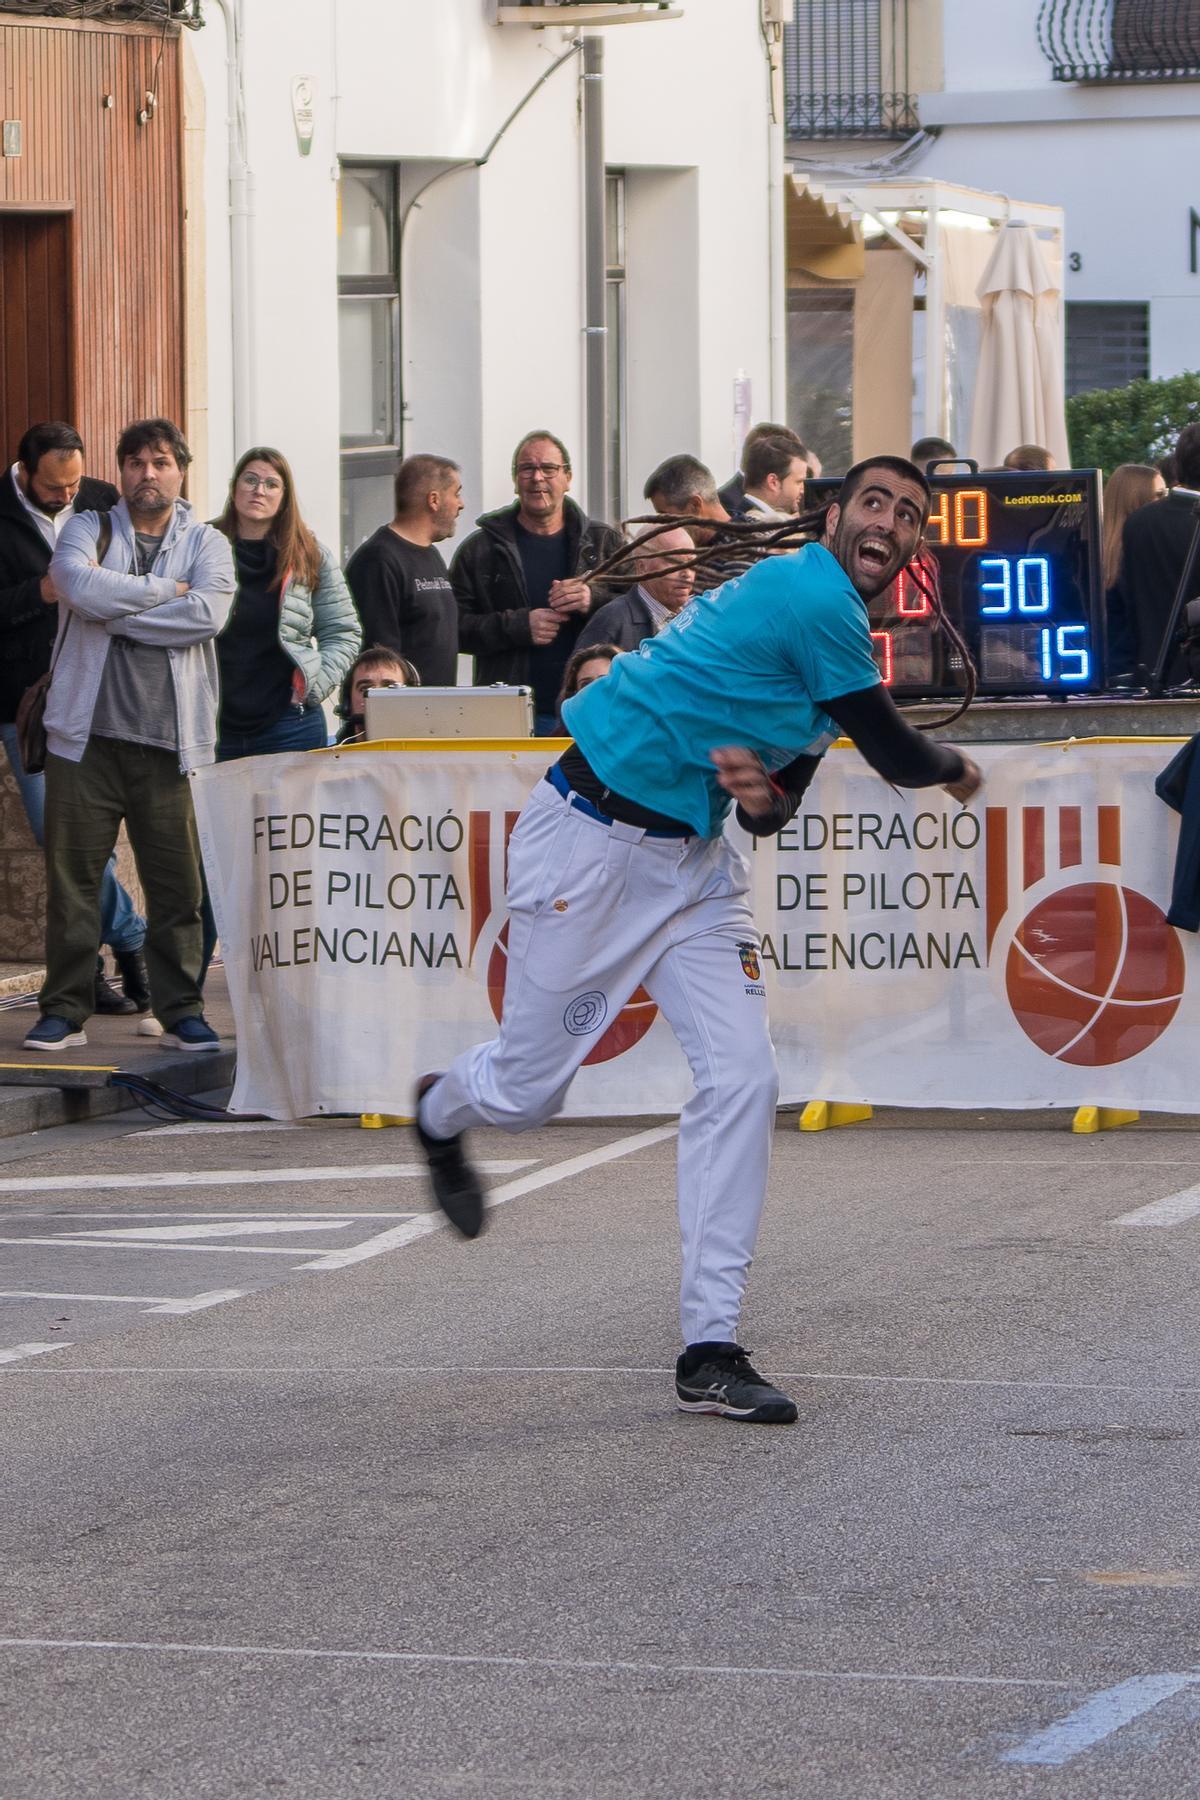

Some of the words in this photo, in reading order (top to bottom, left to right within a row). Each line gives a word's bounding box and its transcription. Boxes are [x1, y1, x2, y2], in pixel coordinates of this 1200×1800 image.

[1069, 252, 1082, 272] 3
[1004, 494, 1082, 505] LedKRON.COM
[980, 558, 1048, 613] 30
[1041, 626, 1088, 680] 15
[253, 809, 464, 854] FEDERACIÓ
[752, 806, 981, 852] EDERACIÓ
[269, 870, 313, 909] DE
[327, 871, 465, 911] PILOTA
[776, 873, 828, 911] DE
[843, 872, 981, 911] PILOTA
[251, 927, 463, 970] VALENCIANA
[761, 932, 981, 970] ALENCIANA
